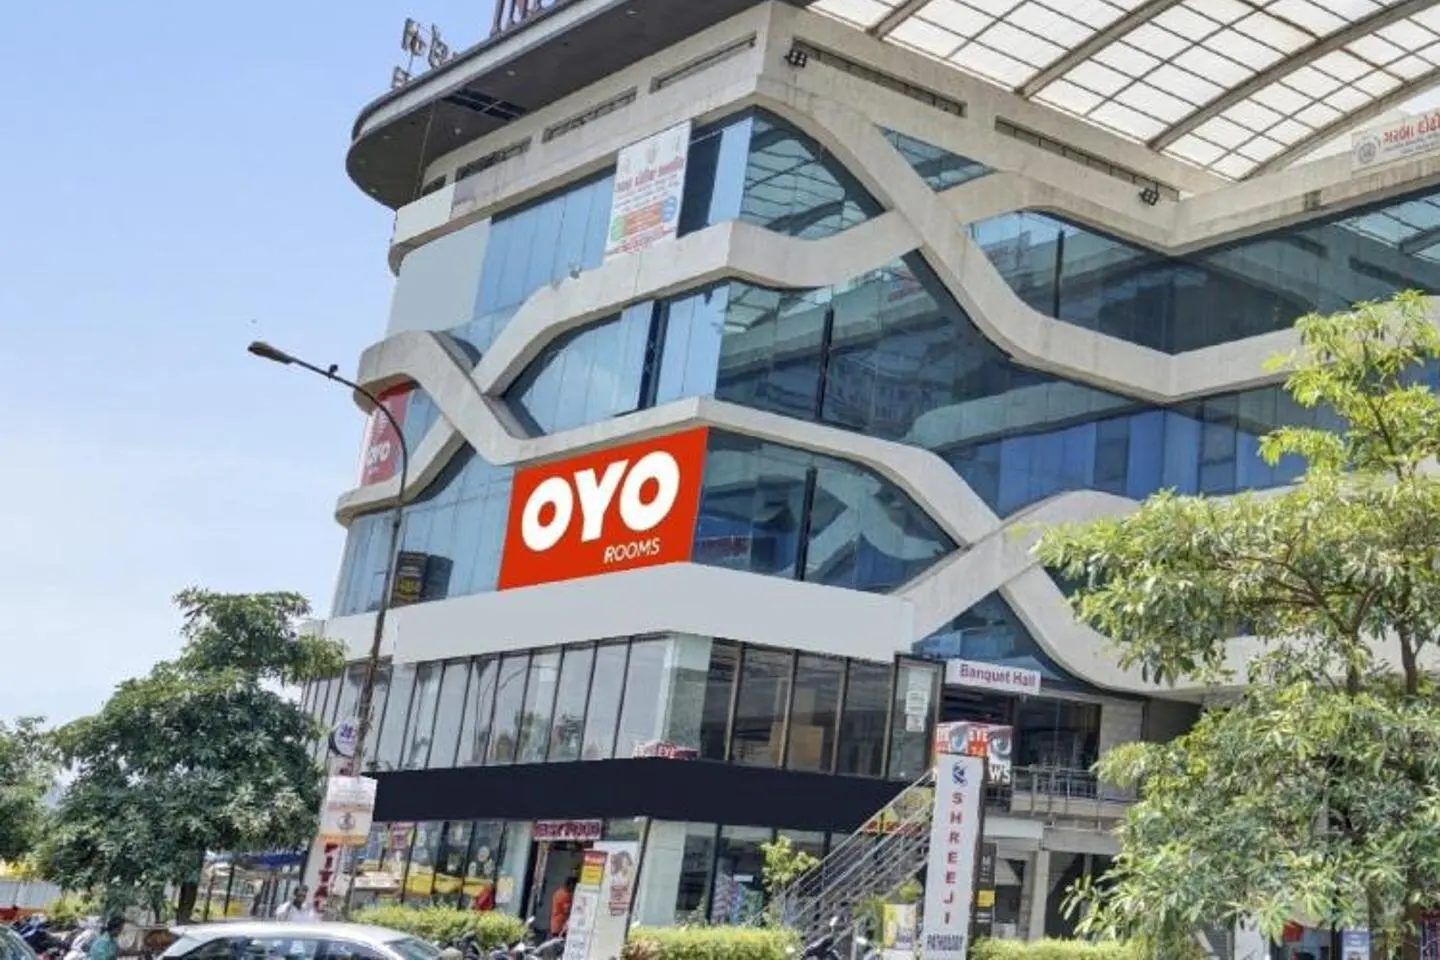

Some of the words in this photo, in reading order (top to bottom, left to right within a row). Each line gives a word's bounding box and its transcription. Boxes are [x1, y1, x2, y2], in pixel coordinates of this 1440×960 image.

[521, 450, 681, 552] OYO
[603, 537, 661, 565] ROOMS
[960, 663, 1011, 685] Banquet
[1012, 671, 1036, 686] Hall
[943, 792, 966, 925] SHREEJI
